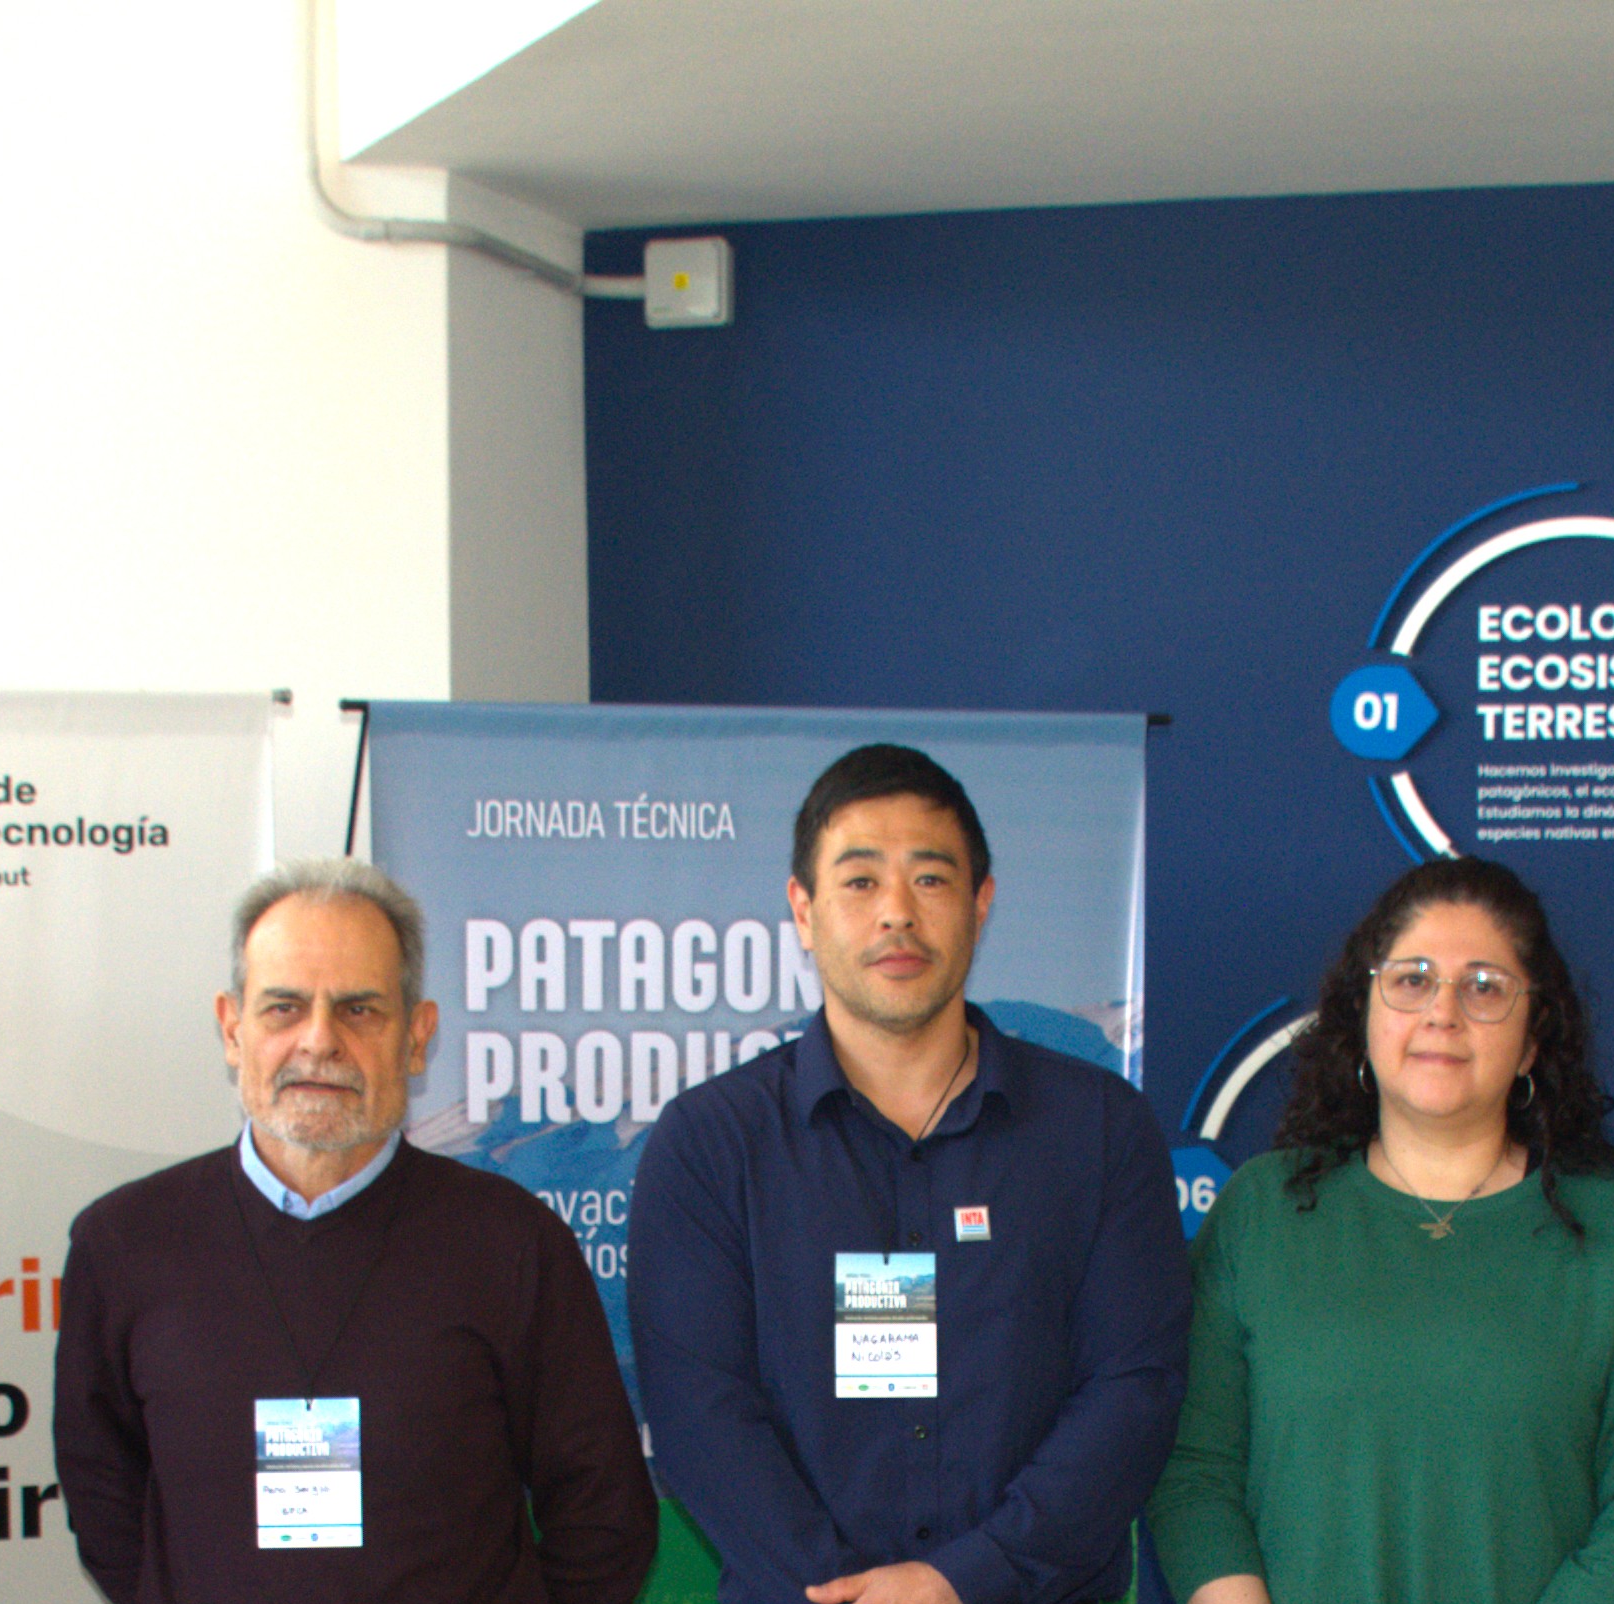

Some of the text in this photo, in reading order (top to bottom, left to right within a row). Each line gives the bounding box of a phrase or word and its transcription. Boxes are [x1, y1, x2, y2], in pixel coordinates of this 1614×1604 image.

[1353, 692, 1399, 730] 01
[1477, 765, 1547, 777] Hacemos
[1575, 785, 1589, 797] el
[466, 793, 736, 839] JORNADA TÉCNICA
[1477, 805, 1562, 818] Estudiamos
[1565, 806, 1579, 818] la
[1477, 827, 1541, 842] especies
[1544, 827, 1598, 839] nativas
[960, 1211, 984, 1226] INTA
